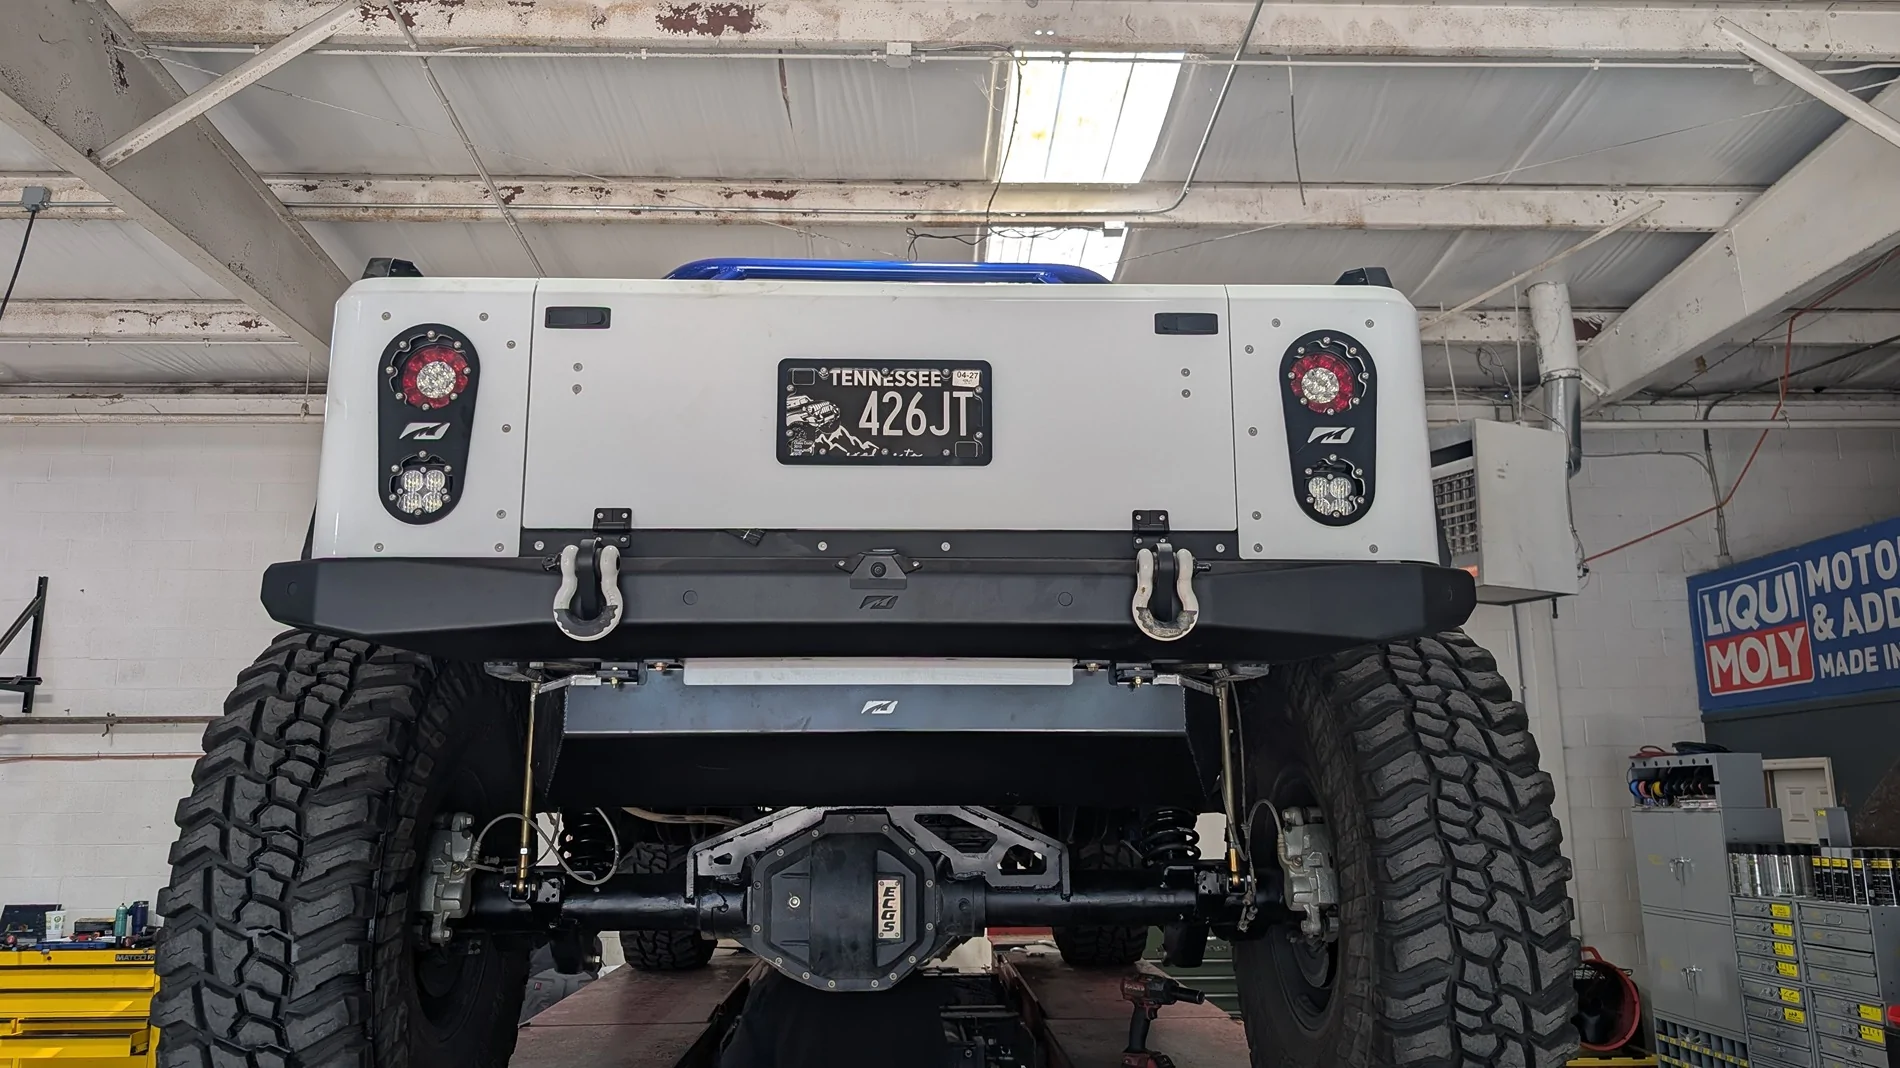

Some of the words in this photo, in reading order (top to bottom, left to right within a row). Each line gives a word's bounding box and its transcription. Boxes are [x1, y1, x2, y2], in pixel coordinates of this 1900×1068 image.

[829, 369, 942, 387] TENNESSEE
[956, 371, 978, 379] 04-27
[858, 391, 974, 436] 426JT
[1805, 535, 1900, 597] MOTO
[1702, 571, 1799, 637] LIQUI
[1812, 603, 1837, 642] &
[1709, 627, 1806, 688] MOLY
[1818, 646, 1879, 678] MADE
[881, 887, 898, 932] ECGS
